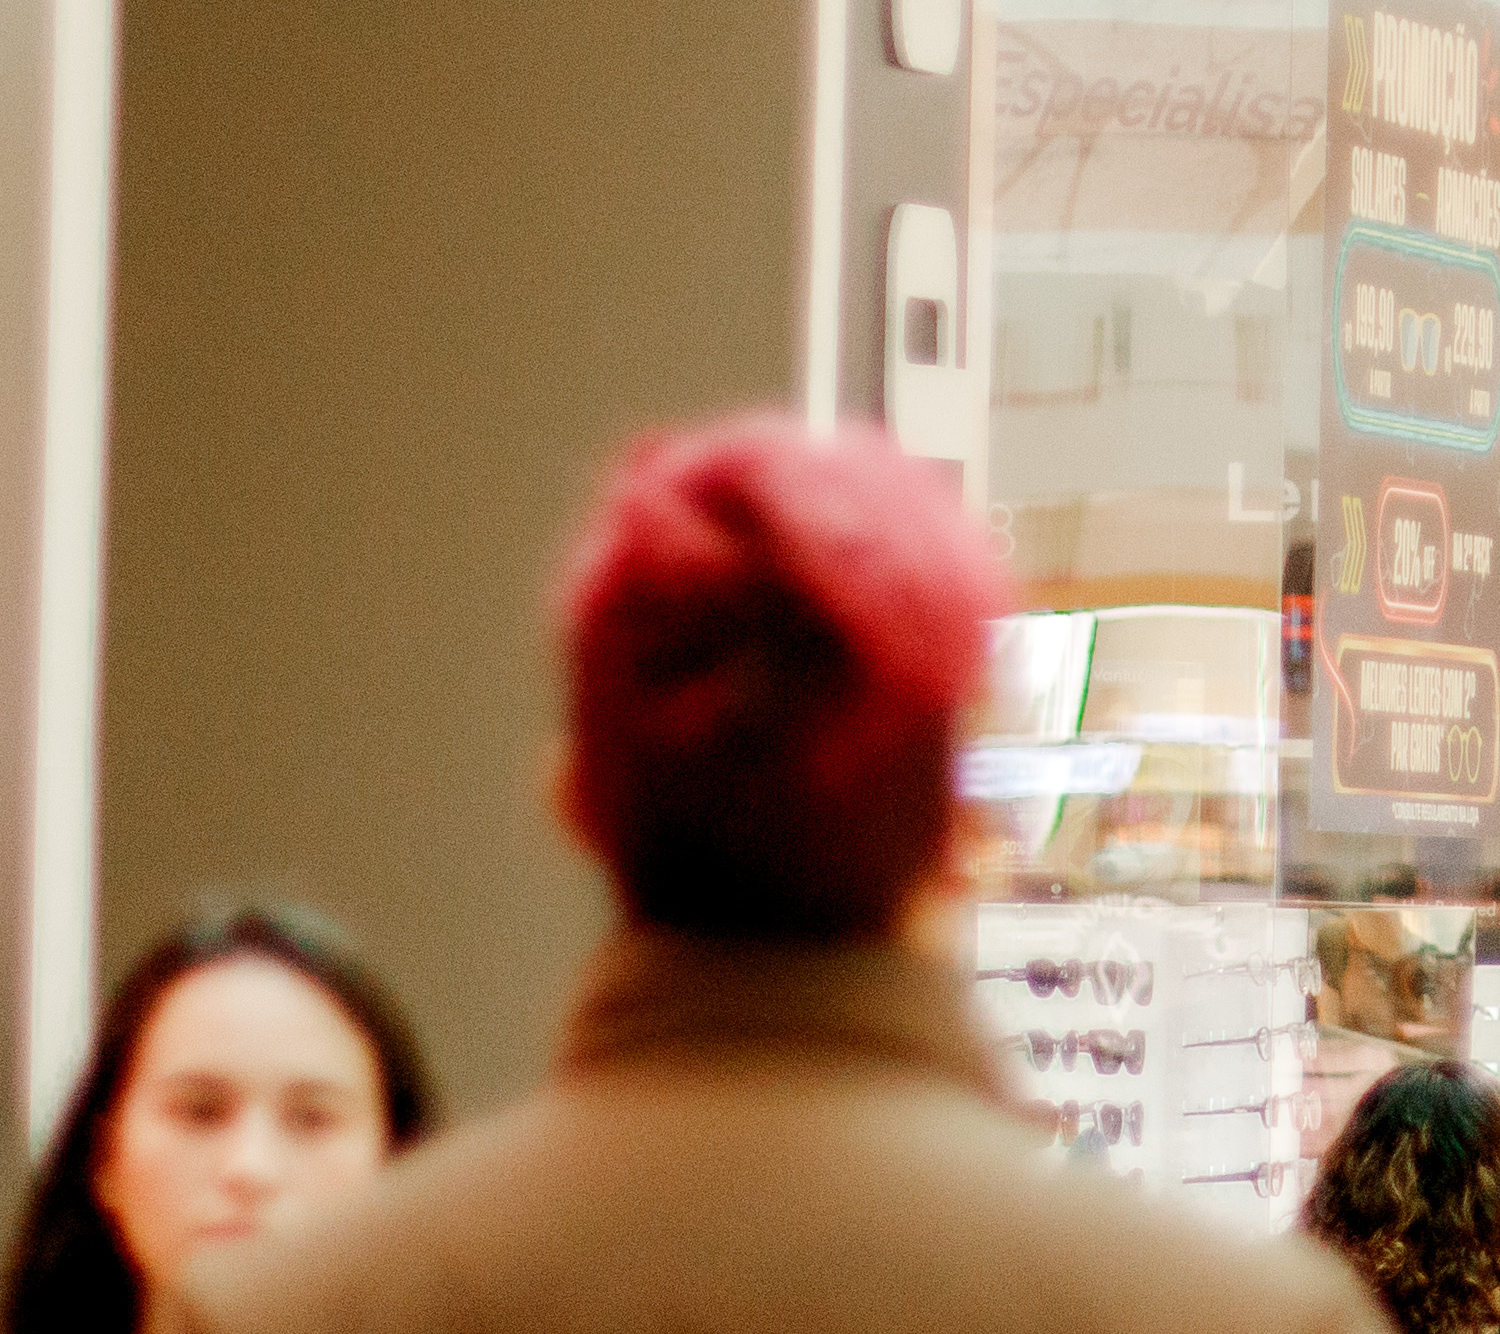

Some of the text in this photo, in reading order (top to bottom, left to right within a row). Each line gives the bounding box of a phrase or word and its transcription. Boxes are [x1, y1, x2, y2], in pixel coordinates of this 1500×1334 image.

[1372, 10, 1479, 155] PROMOÇÃO
[1392, 517, 1421, 589] 20%
[1360, 660, 1407, 713] MELHORES
[1408, 664, 1442, 716] LENTES
[1391, 721, 1410, 771] PAR
